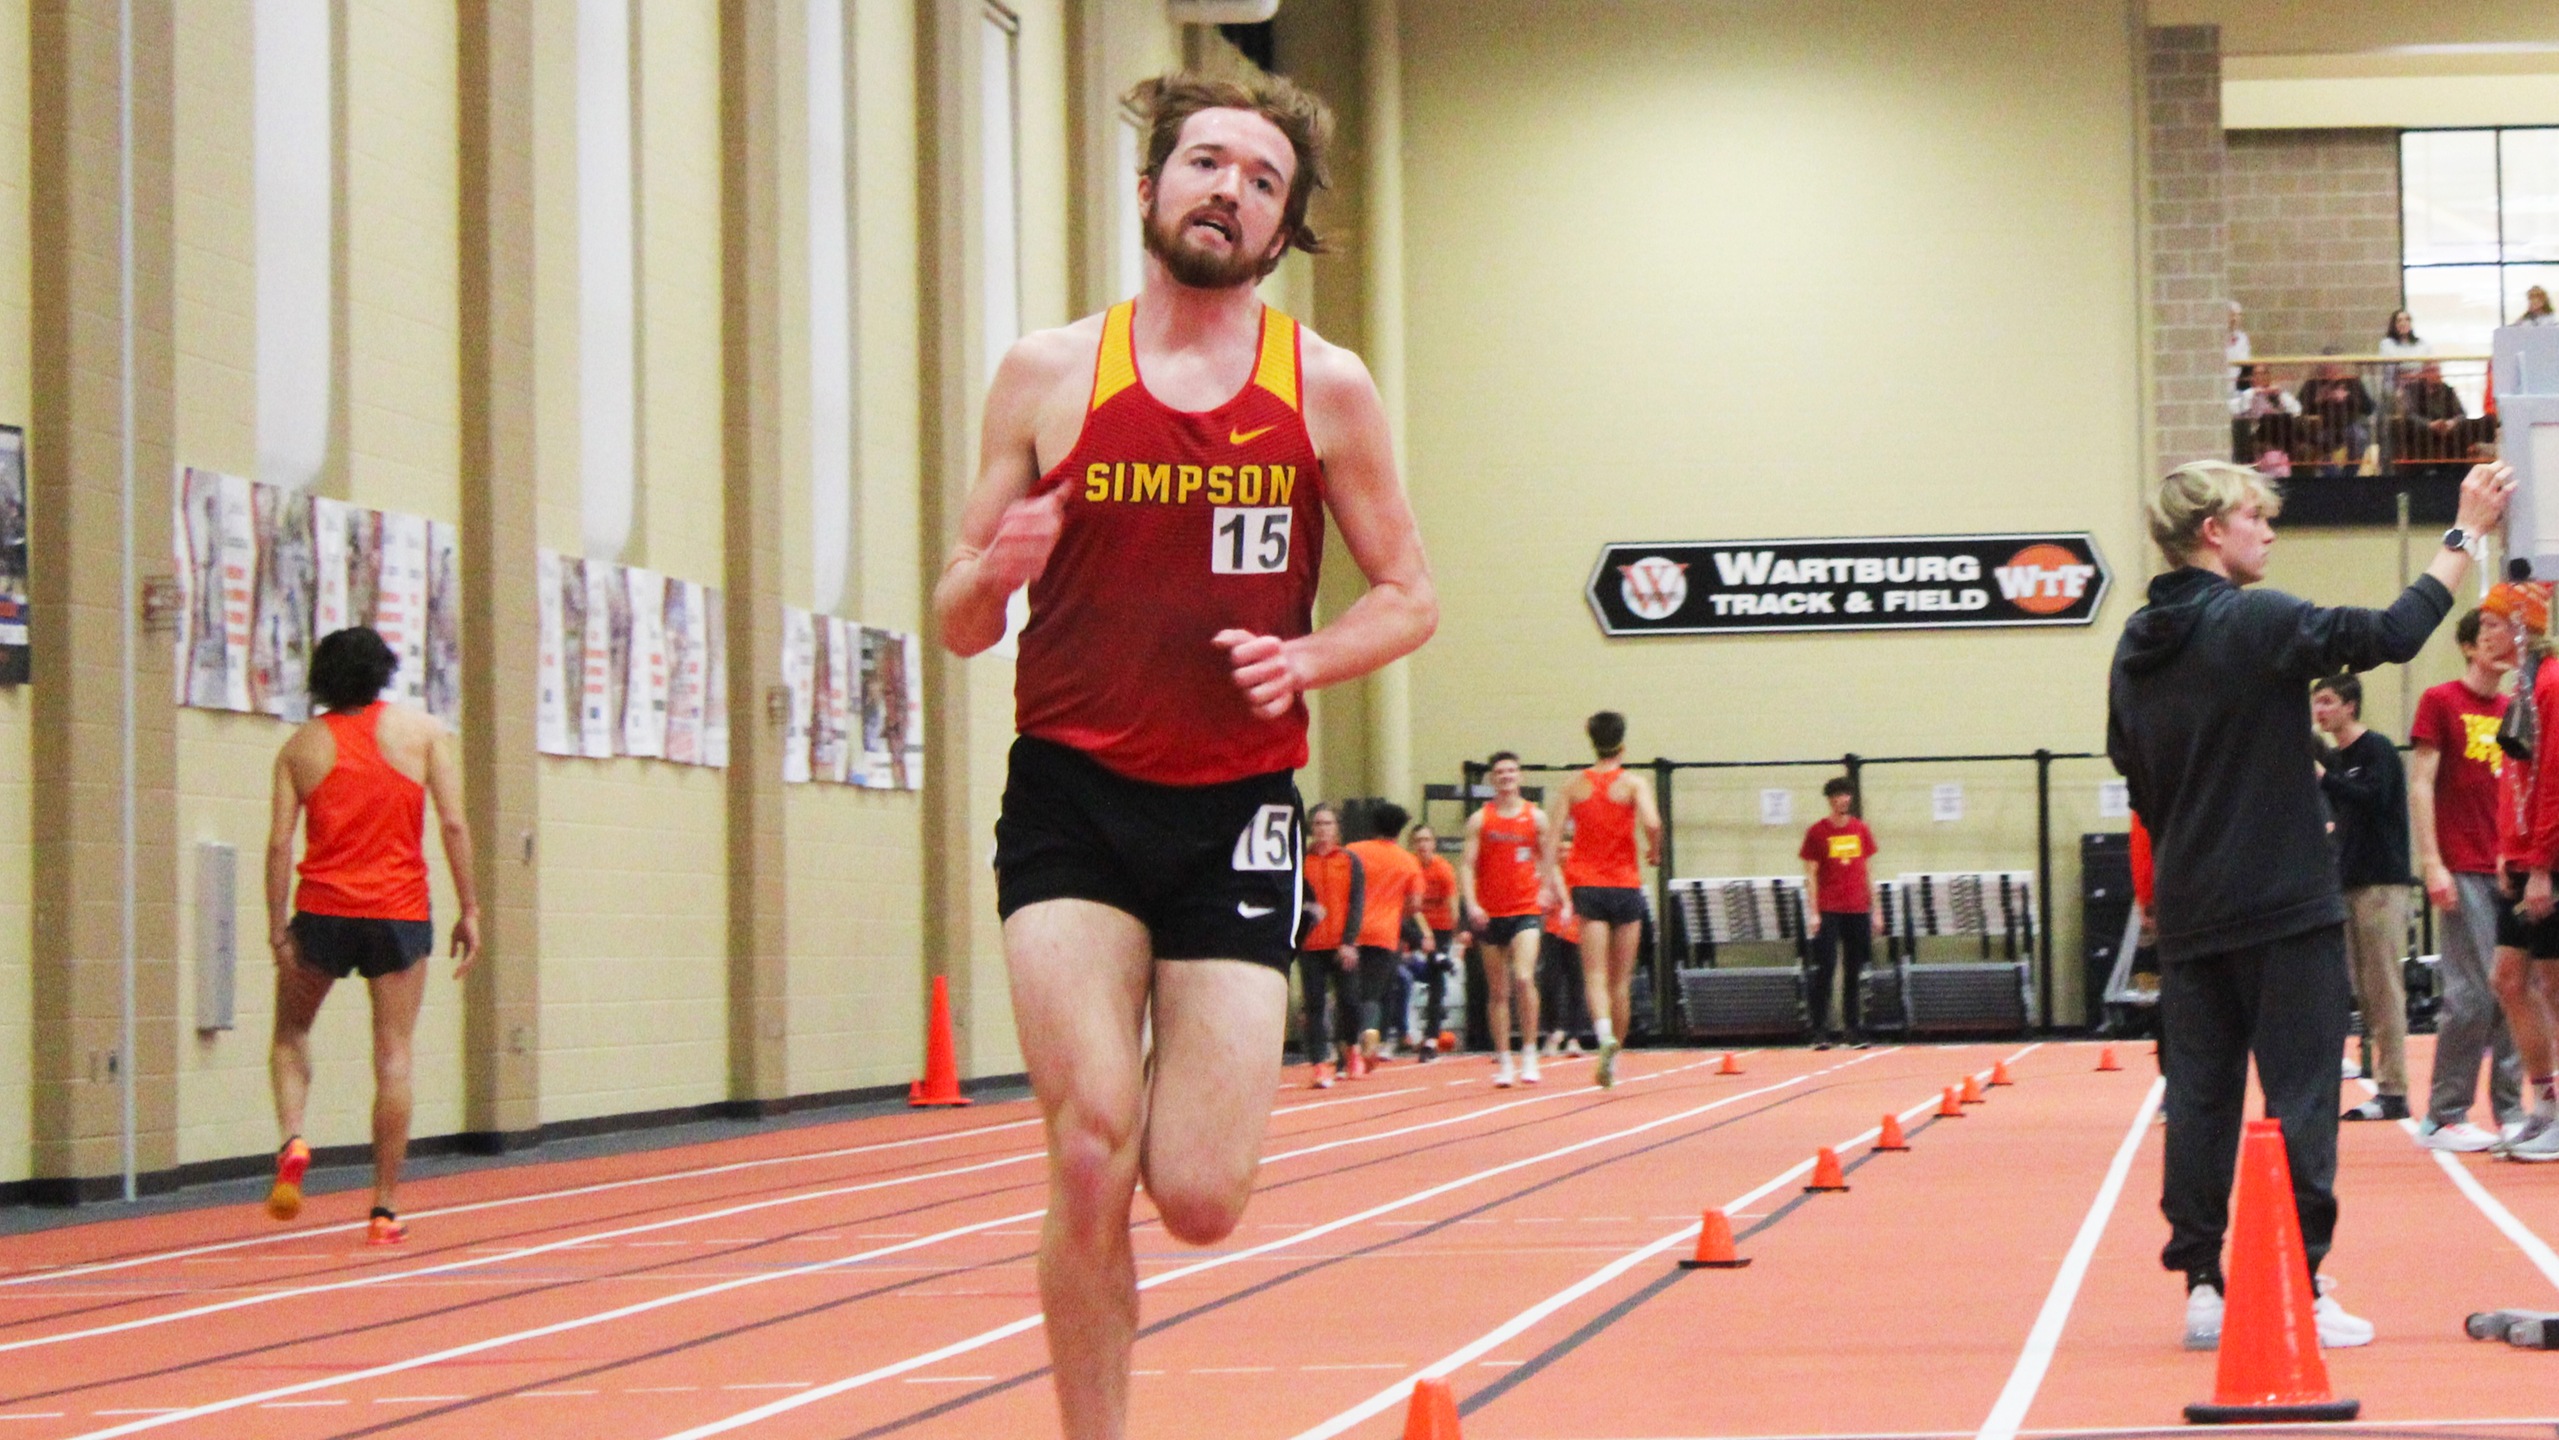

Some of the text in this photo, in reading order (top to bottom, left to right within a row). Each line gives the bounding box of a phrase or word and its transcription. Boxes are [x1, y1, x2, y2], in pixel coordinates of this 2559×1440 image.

[1085, 462, 1296, 505] SIMPSON
[1219, 513, 1289, 570] 15
[1713, 550, 1982, 586] WARTBURG
[1709, 588, 1990, 616] TRACK & FIELD
